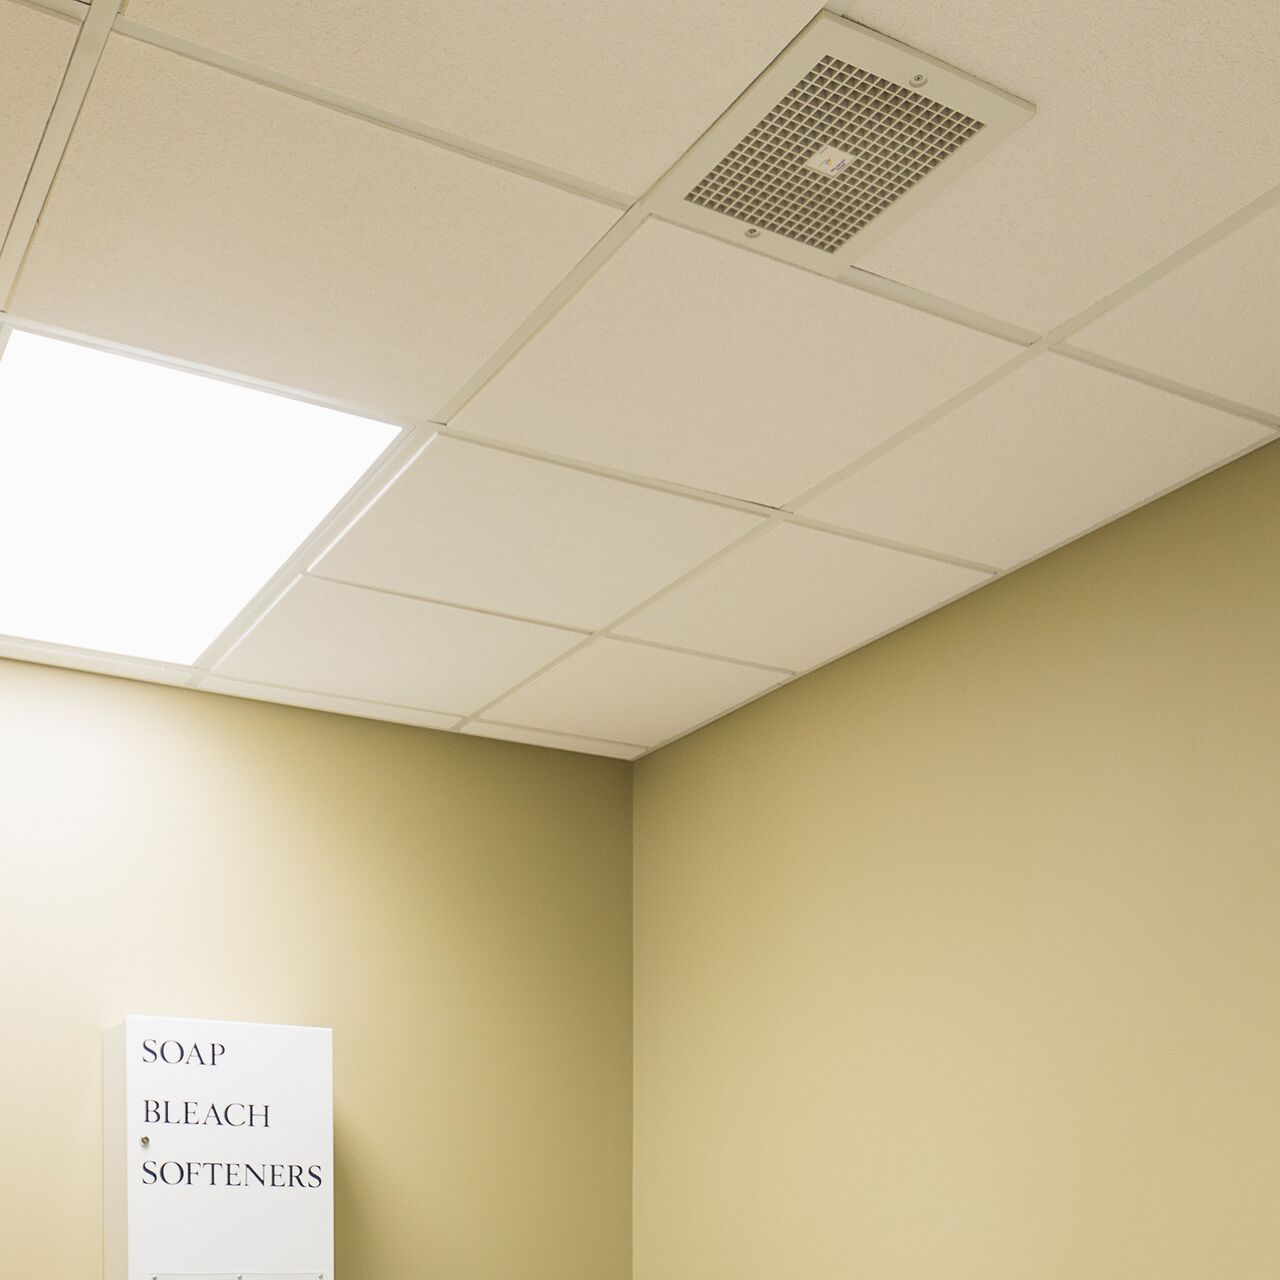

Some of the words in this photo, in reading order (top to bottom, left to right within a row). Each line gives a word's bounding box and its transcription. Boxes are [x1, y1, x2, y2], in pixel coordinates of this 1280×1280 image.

[142, 1038, 226, 1066] SOAP
[143, 1099, 270, 1128] BLEACH
[142, 1160, 323, 1189] SOFTENERS
